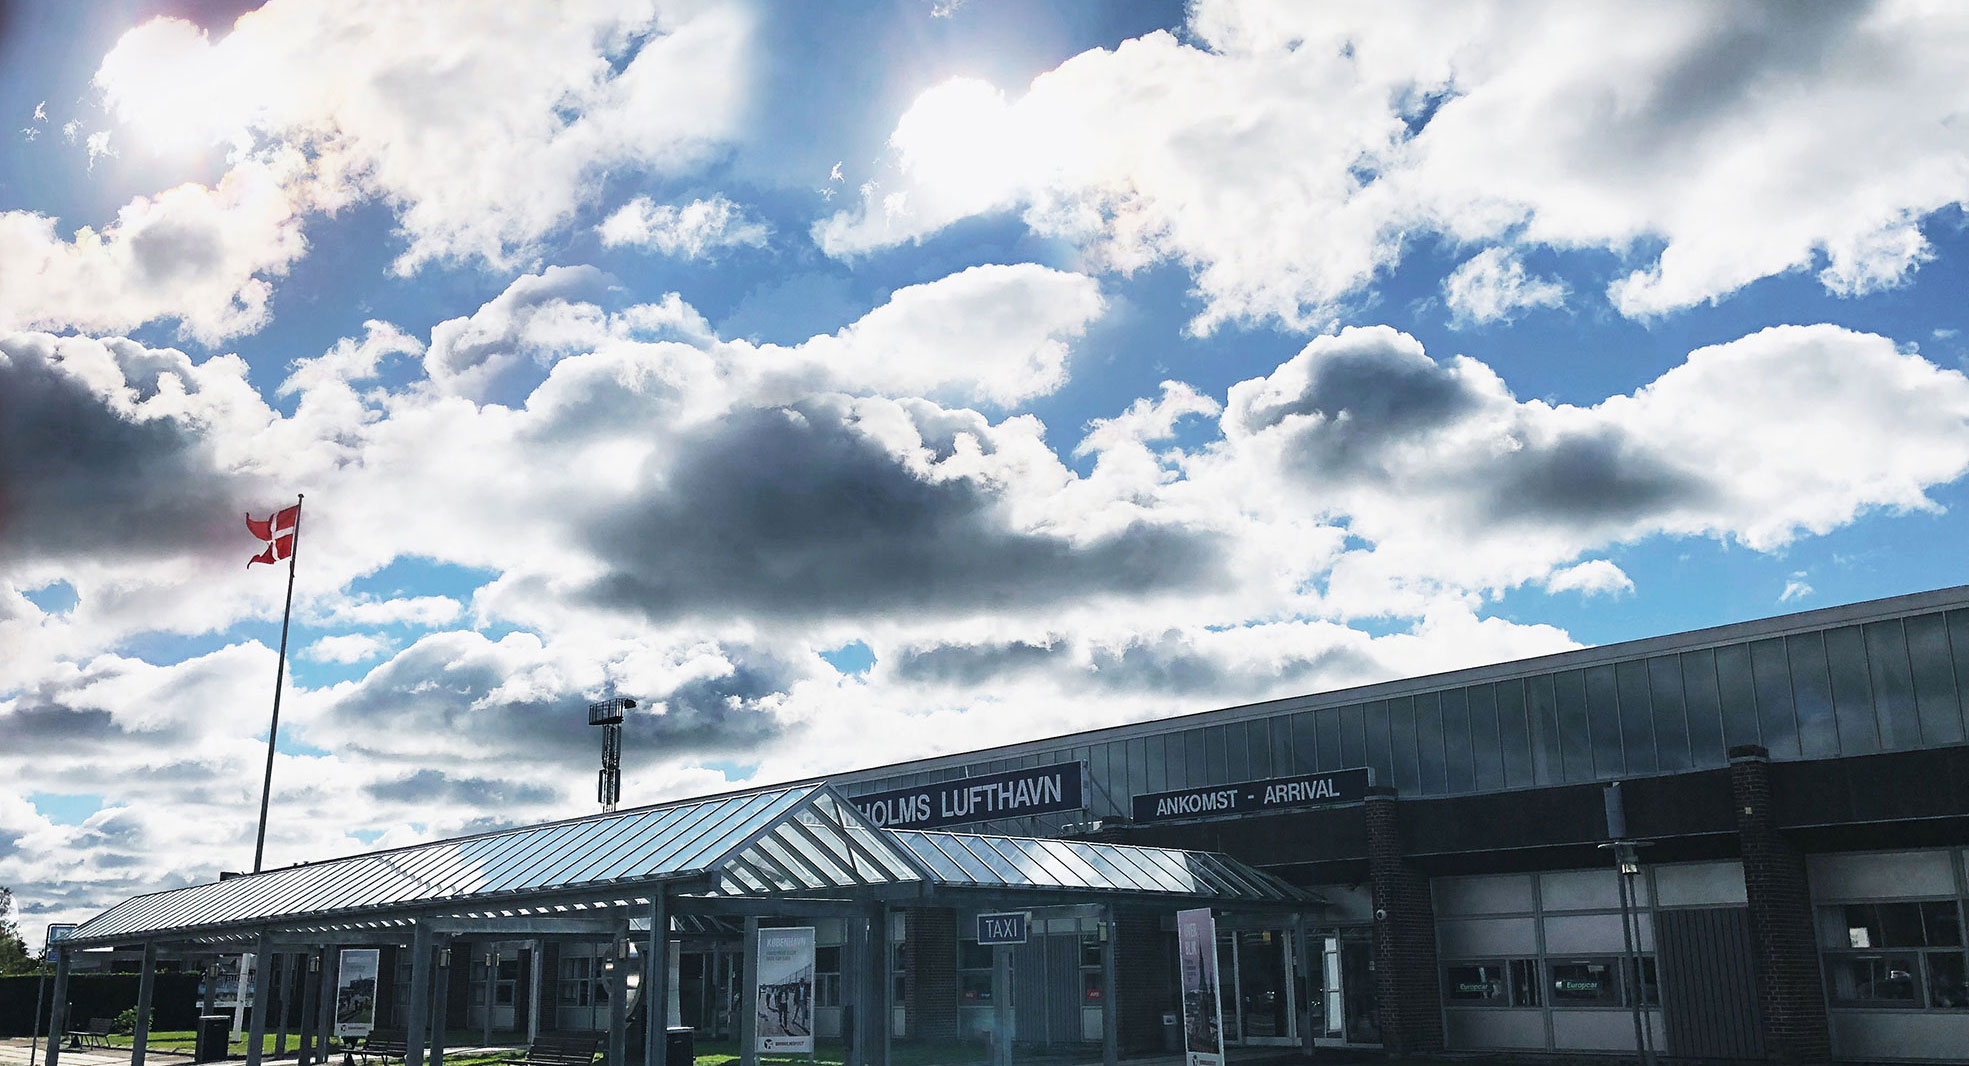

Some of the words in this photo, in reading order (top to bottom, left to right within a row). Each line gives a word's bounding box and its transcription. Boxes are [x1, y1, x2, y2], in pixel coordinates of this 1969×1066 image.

[941, 774, 1061, 818] LUFTHAVN
[1156, 789, 1238, 816] ANKOMST
[1264, 778, 1341, 805] ARRIVAL
[985, 918, 1017, 938] TAXI
[1566, 981, 1598, 991] Europcar
